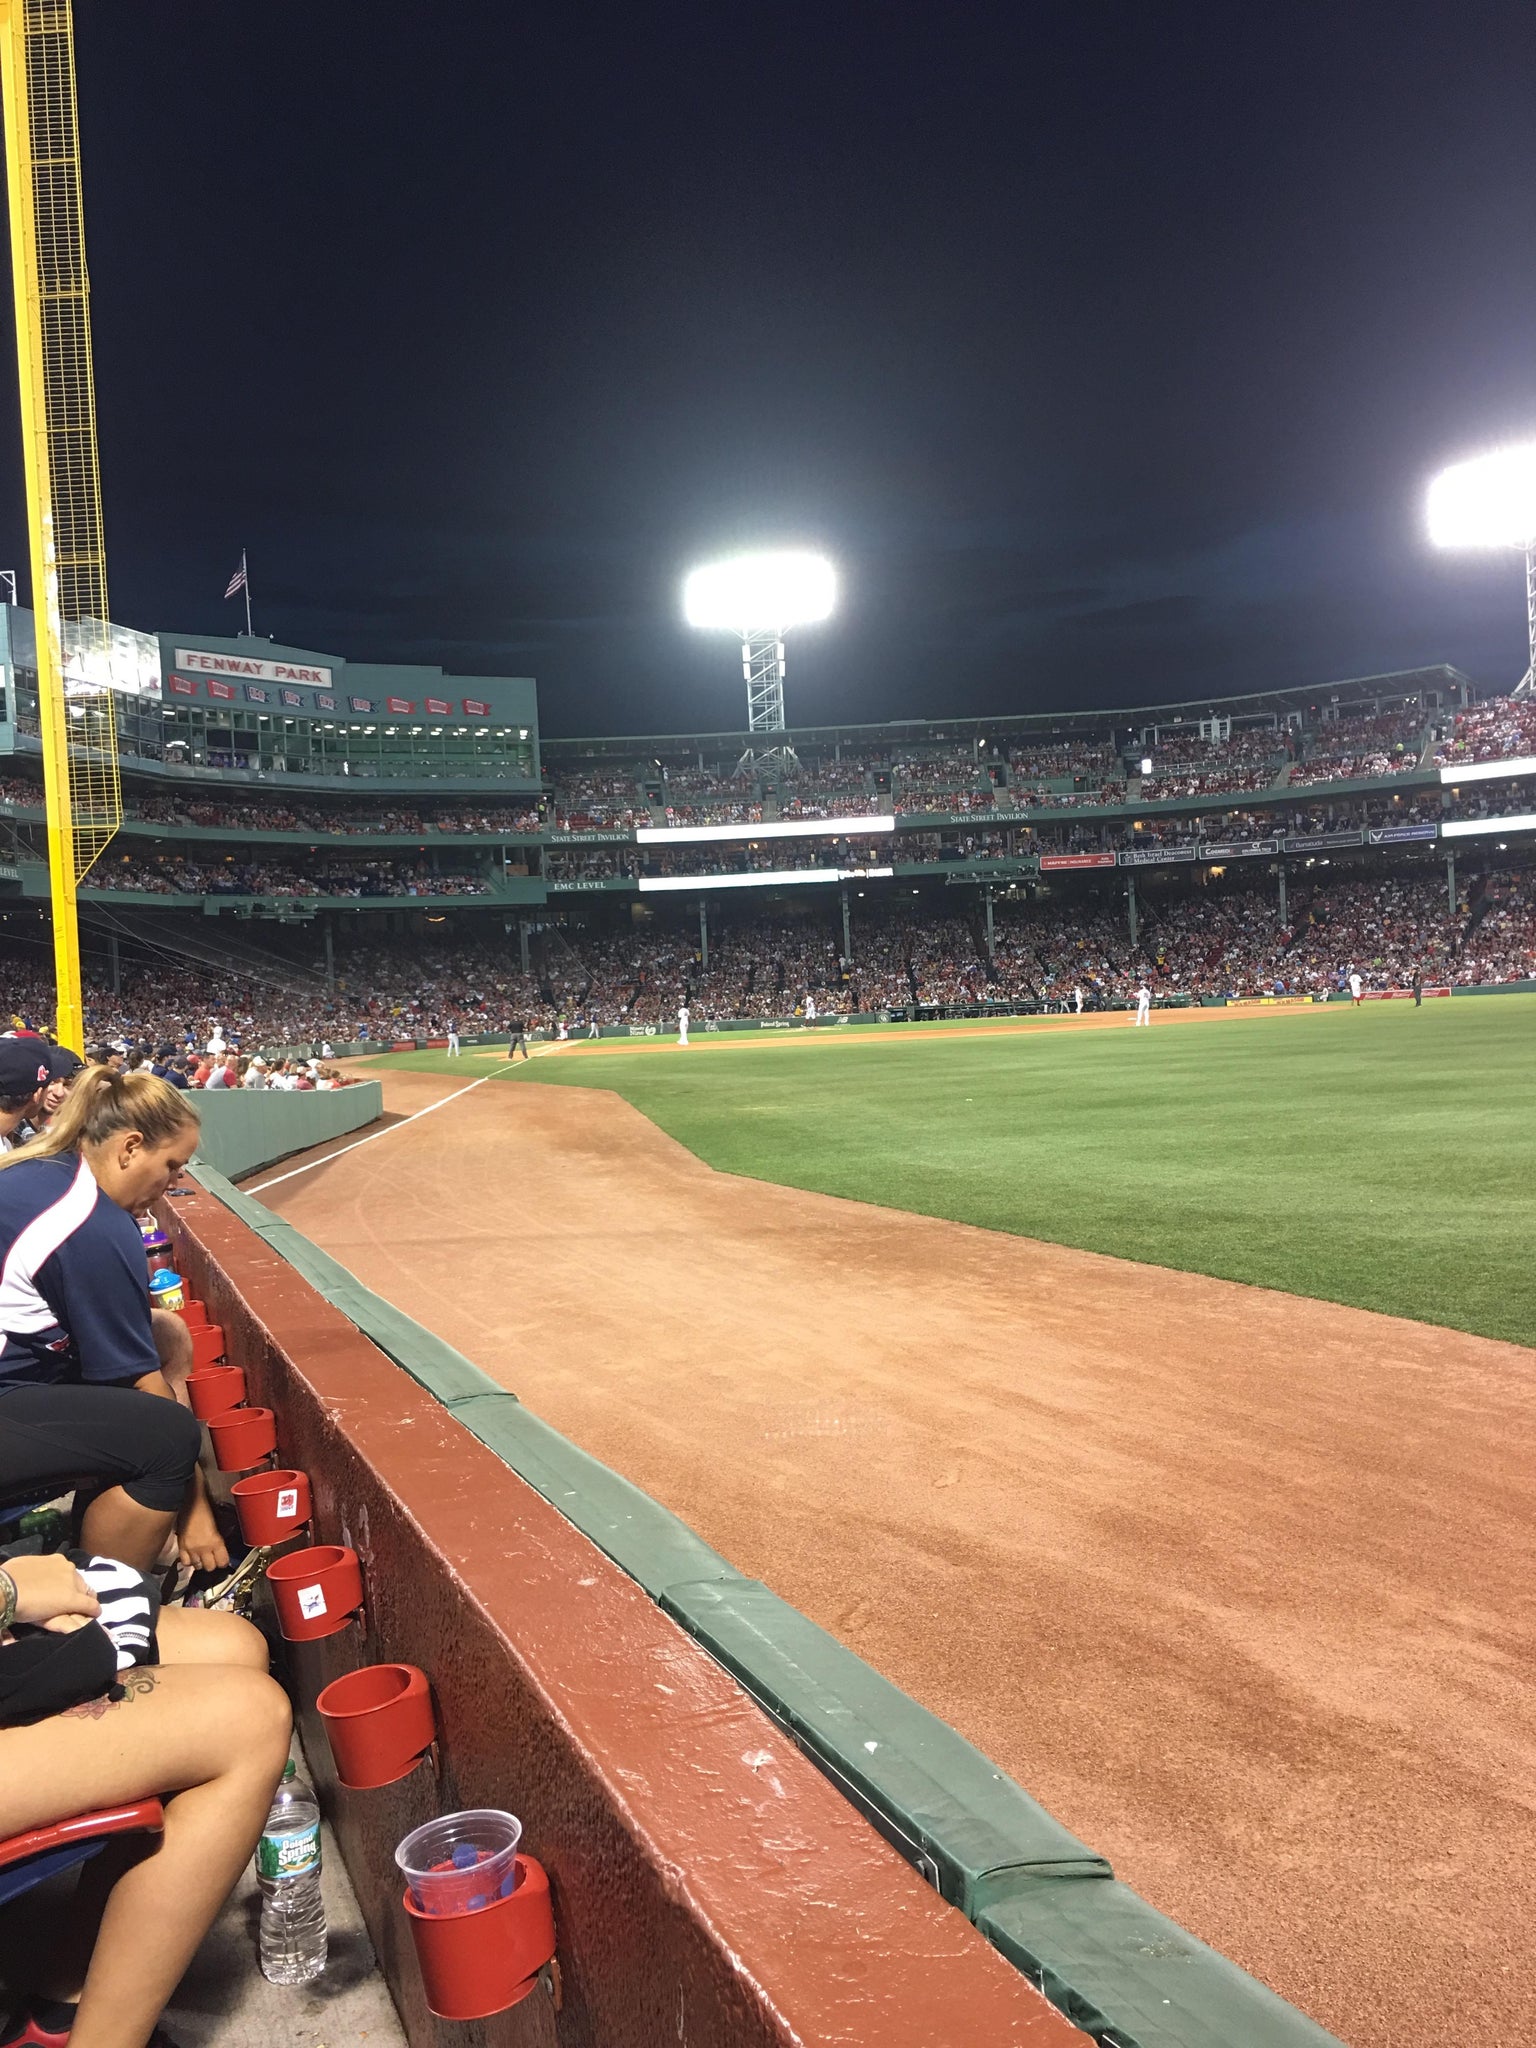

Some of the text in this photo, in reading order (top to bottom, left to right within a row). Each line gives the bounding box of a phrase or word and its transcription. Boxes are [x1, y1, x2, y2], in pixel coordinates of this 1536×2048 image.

[187, 654, 322, 683] FENWAY PARK
[951, 812, 1029, 823] STATE STREET PAVILION
[551, 833, 630, 842] STATE STREET PAVILION
[554, 881, 606, 890] EMC LEVEL
[282, 1832, 313, 1851] Poland
[278, 1840, 317, 1866] Spring
